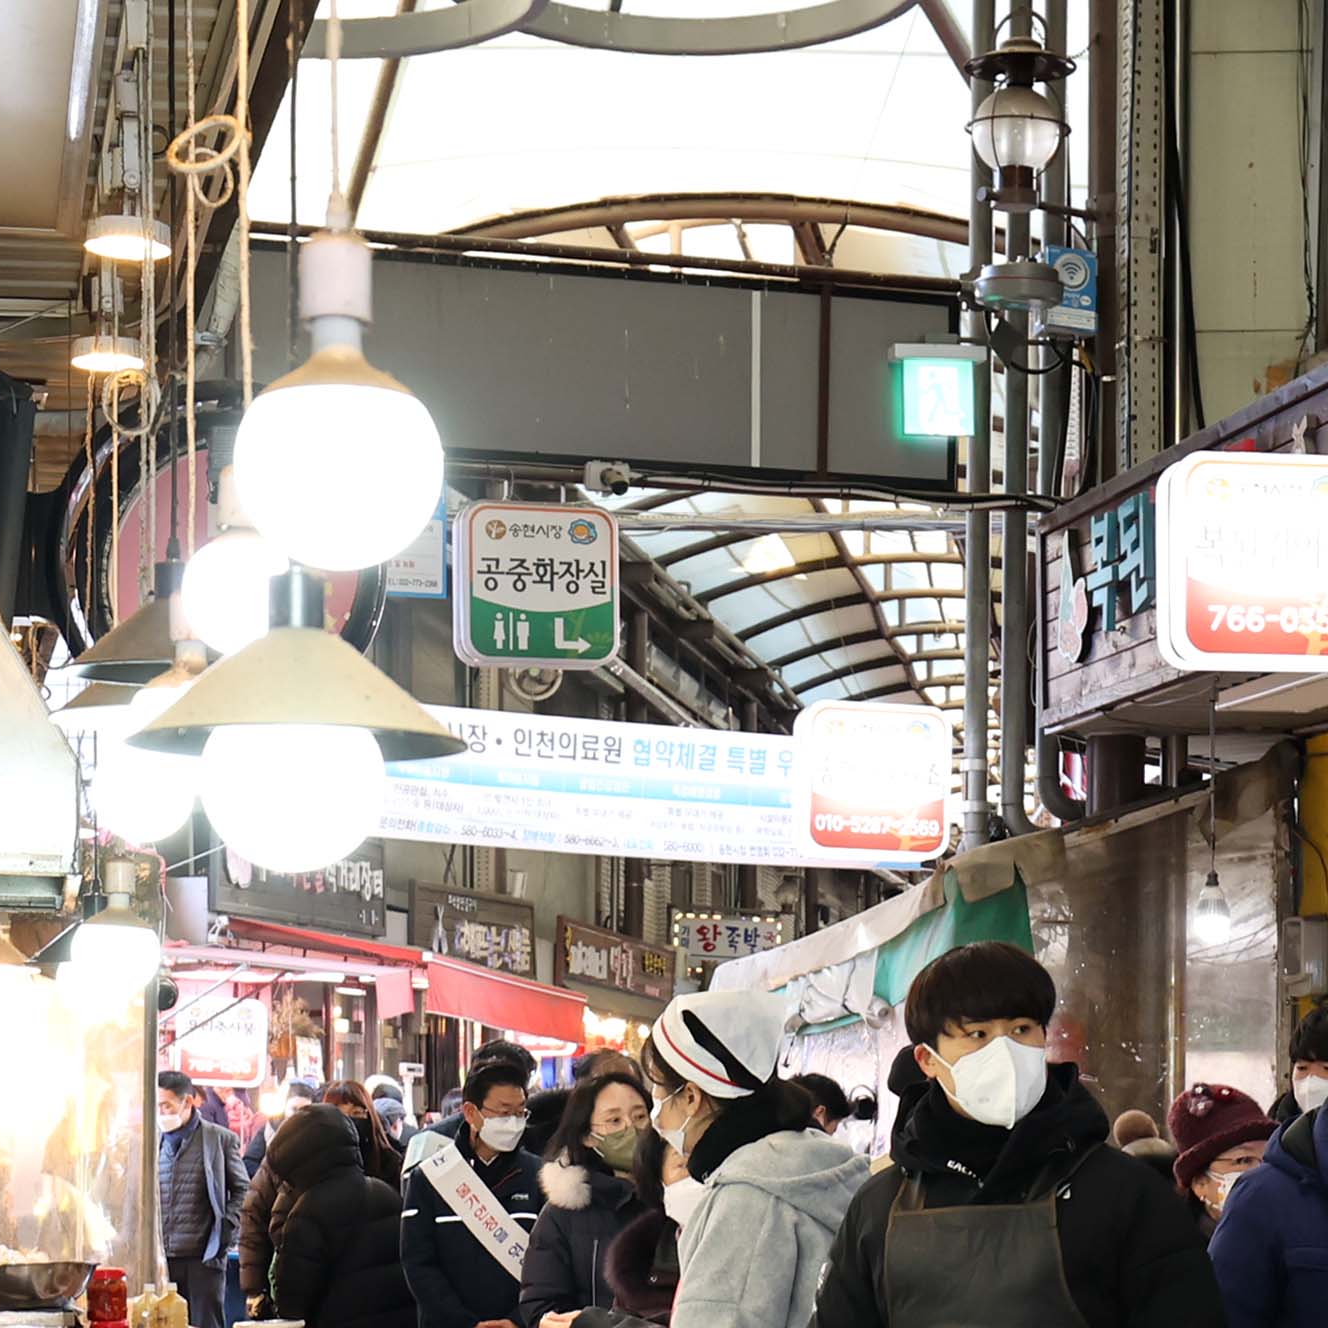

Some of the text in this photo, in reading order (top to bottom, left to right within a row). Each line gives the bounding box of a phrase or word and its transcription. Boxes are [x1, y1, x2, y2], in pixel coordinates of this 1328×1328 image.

[508, 523, 563, 539] 송현시장
[476, 557, 607, 596] 공중화장실
[514, 728, 623, 764] 인천의료원
[633, 737, 717, 772] 협약체결
[727, 746, 768, 776] 특별
[696, 923, 761, 954] 왕족발
[455, 1182, 509, 1244] 물가안정을
